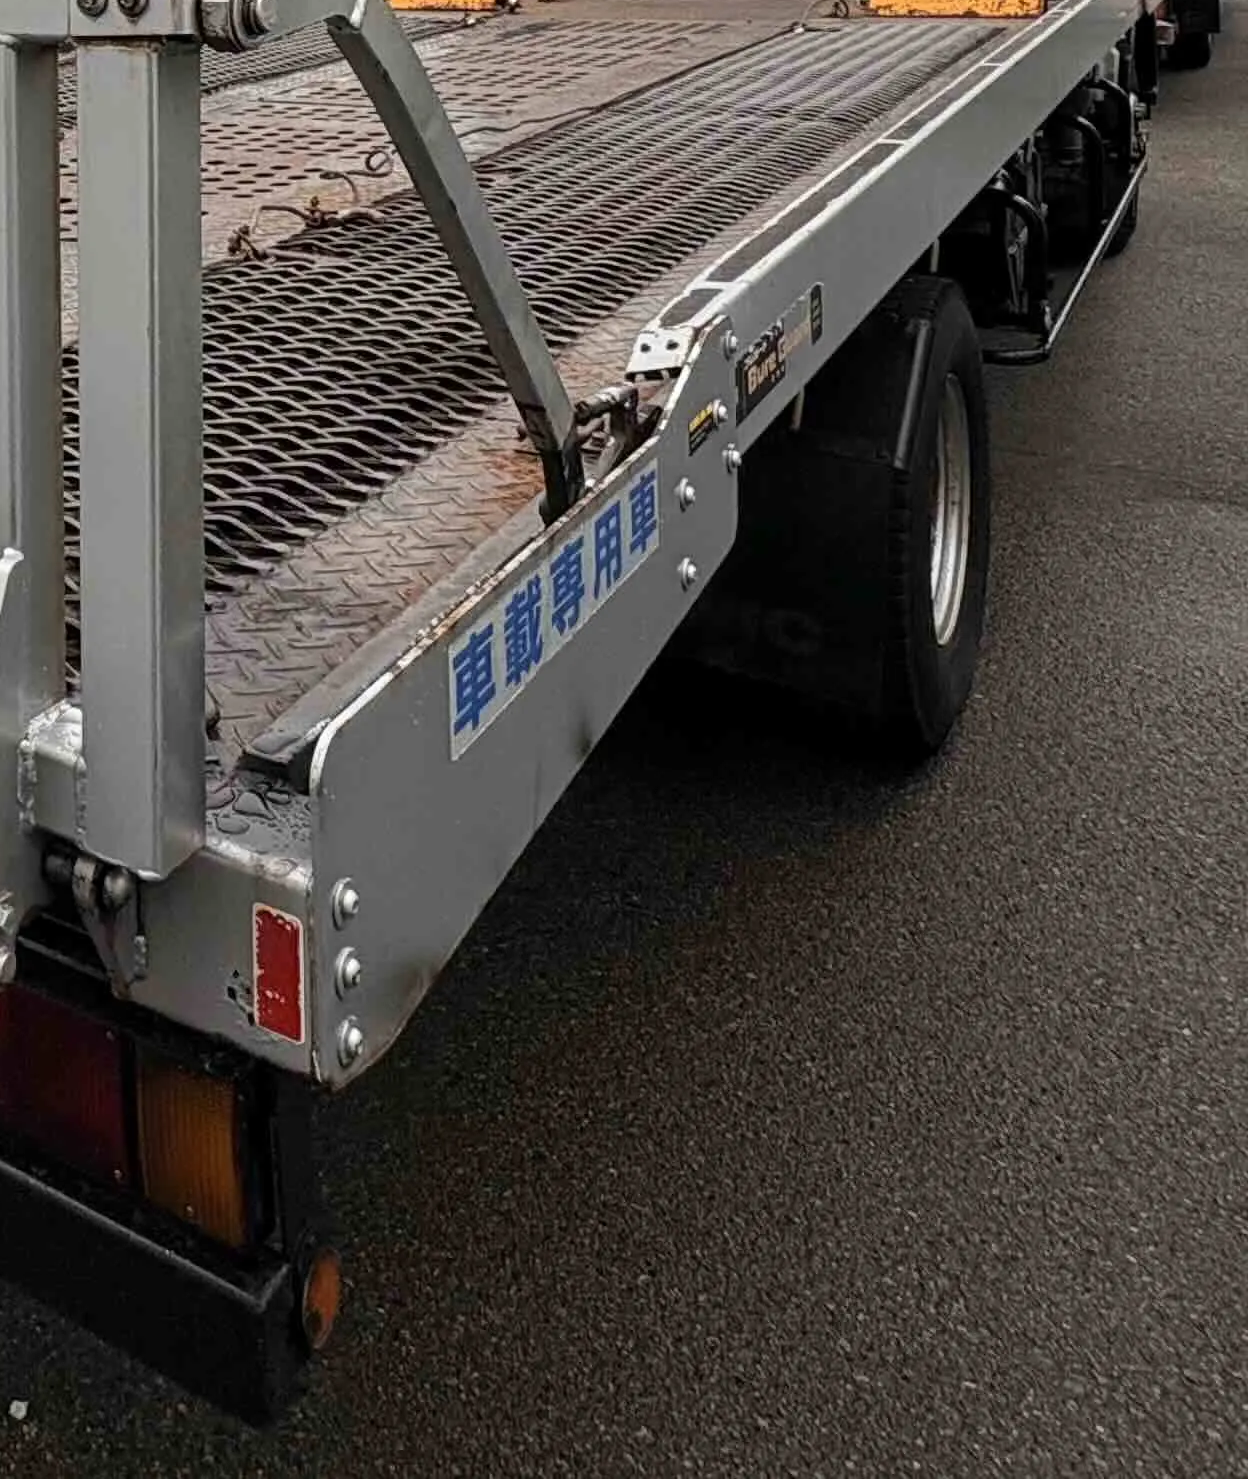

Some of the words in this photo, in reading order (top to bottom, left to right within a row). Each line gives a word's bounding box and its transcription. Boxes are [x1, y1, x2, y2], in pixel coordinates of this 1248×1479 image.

[452, 469, 657, 733] 車載専用車
